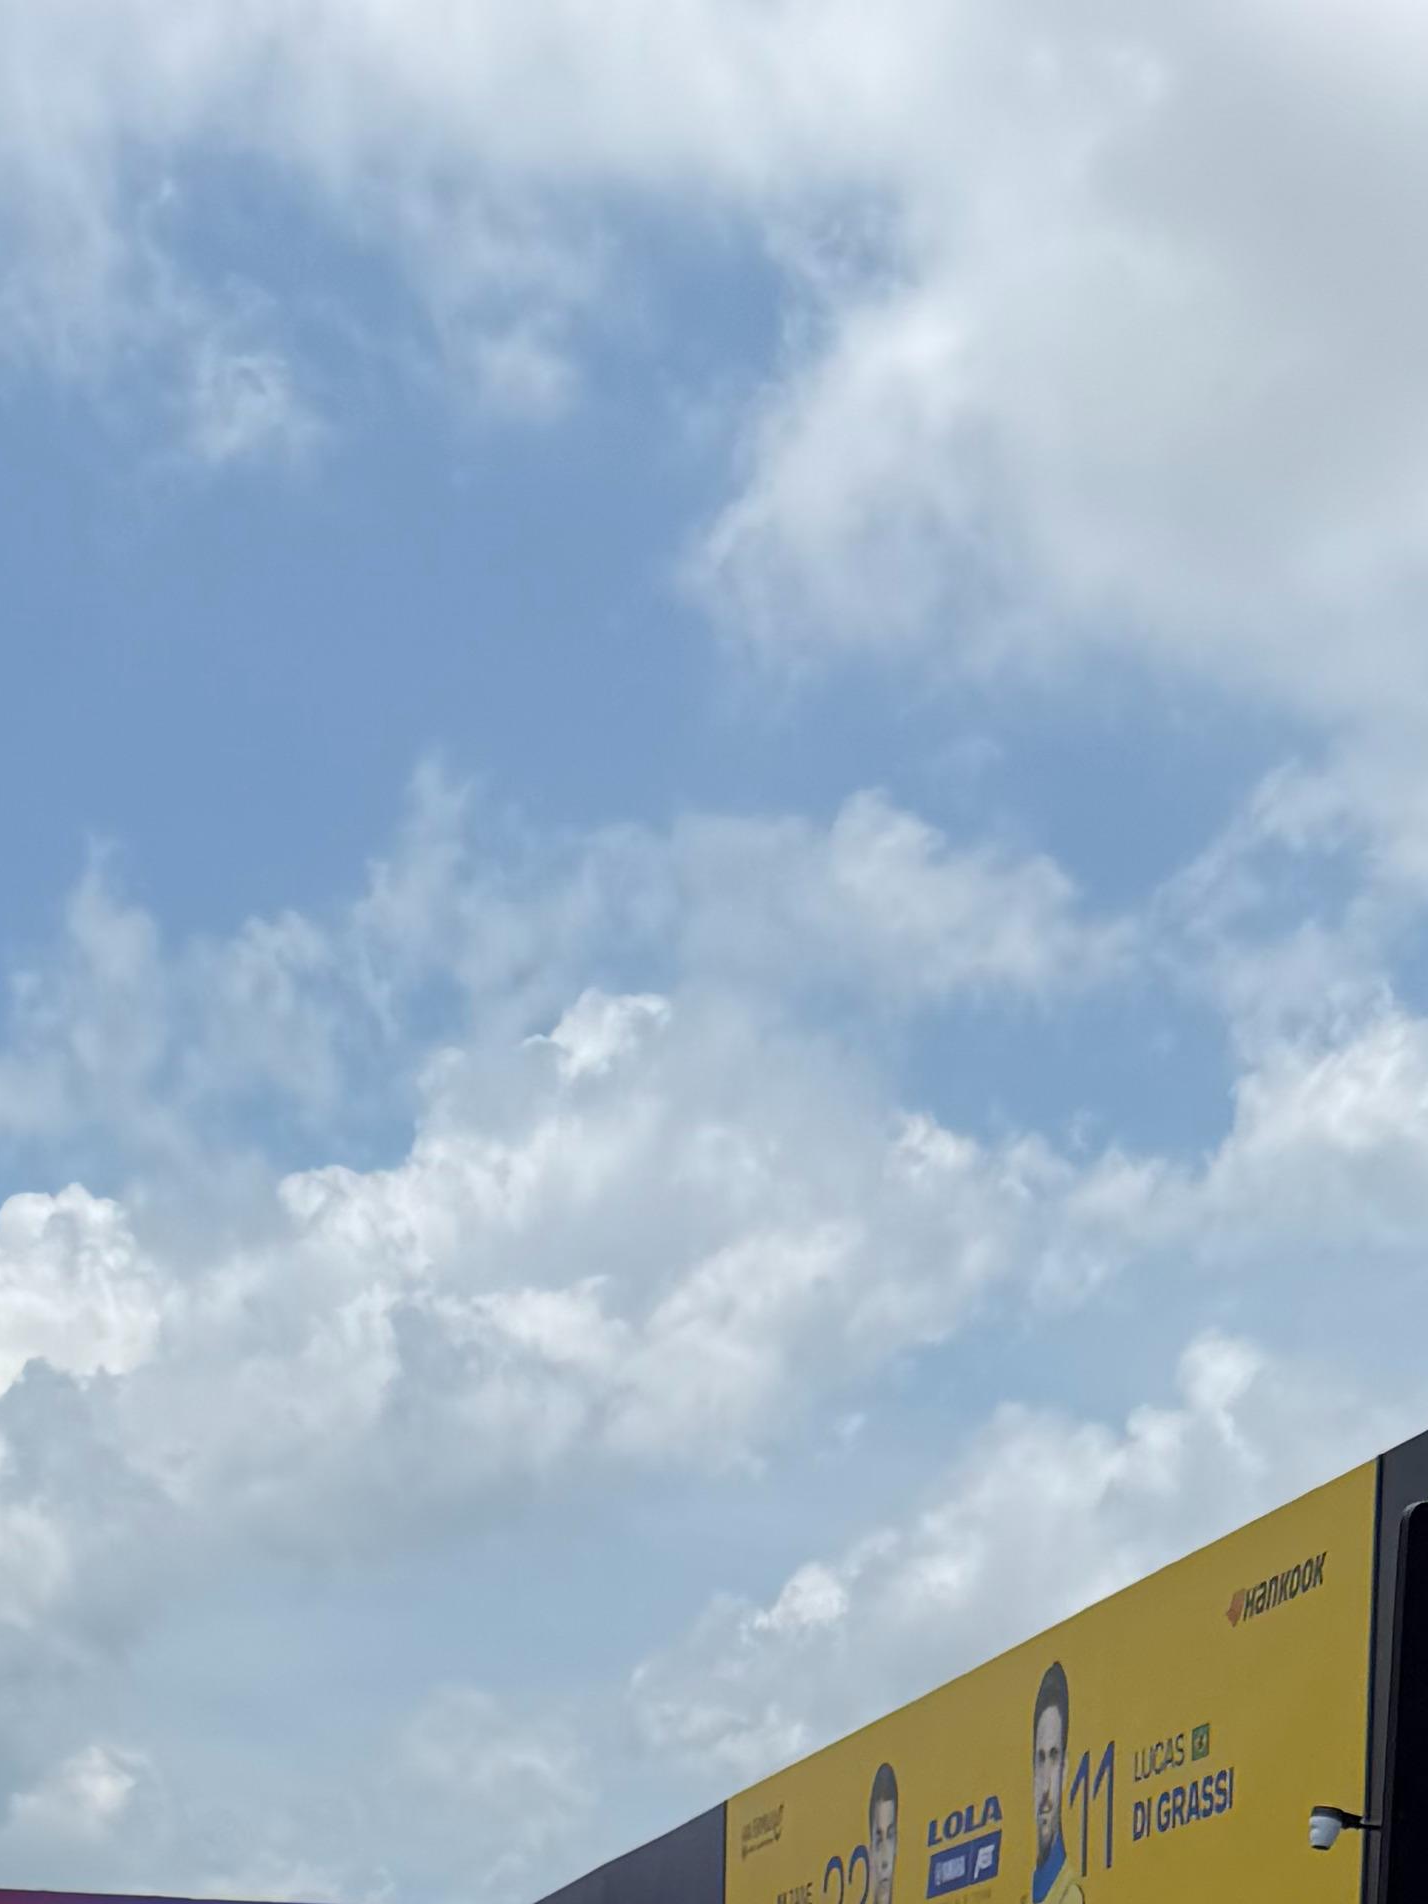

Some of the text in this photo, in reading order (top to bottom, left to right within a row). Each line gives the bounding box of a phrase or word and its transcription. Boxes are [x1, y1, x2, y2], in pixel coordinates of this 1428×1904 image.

[1133, 1732, 1185, 1782] LUCAS
[927, 1795, 1003, 1848] LOLA
[1069, 1740, 1116, 1878] 11
[1132, 1766, 1235, 1842] DI GRASSI
